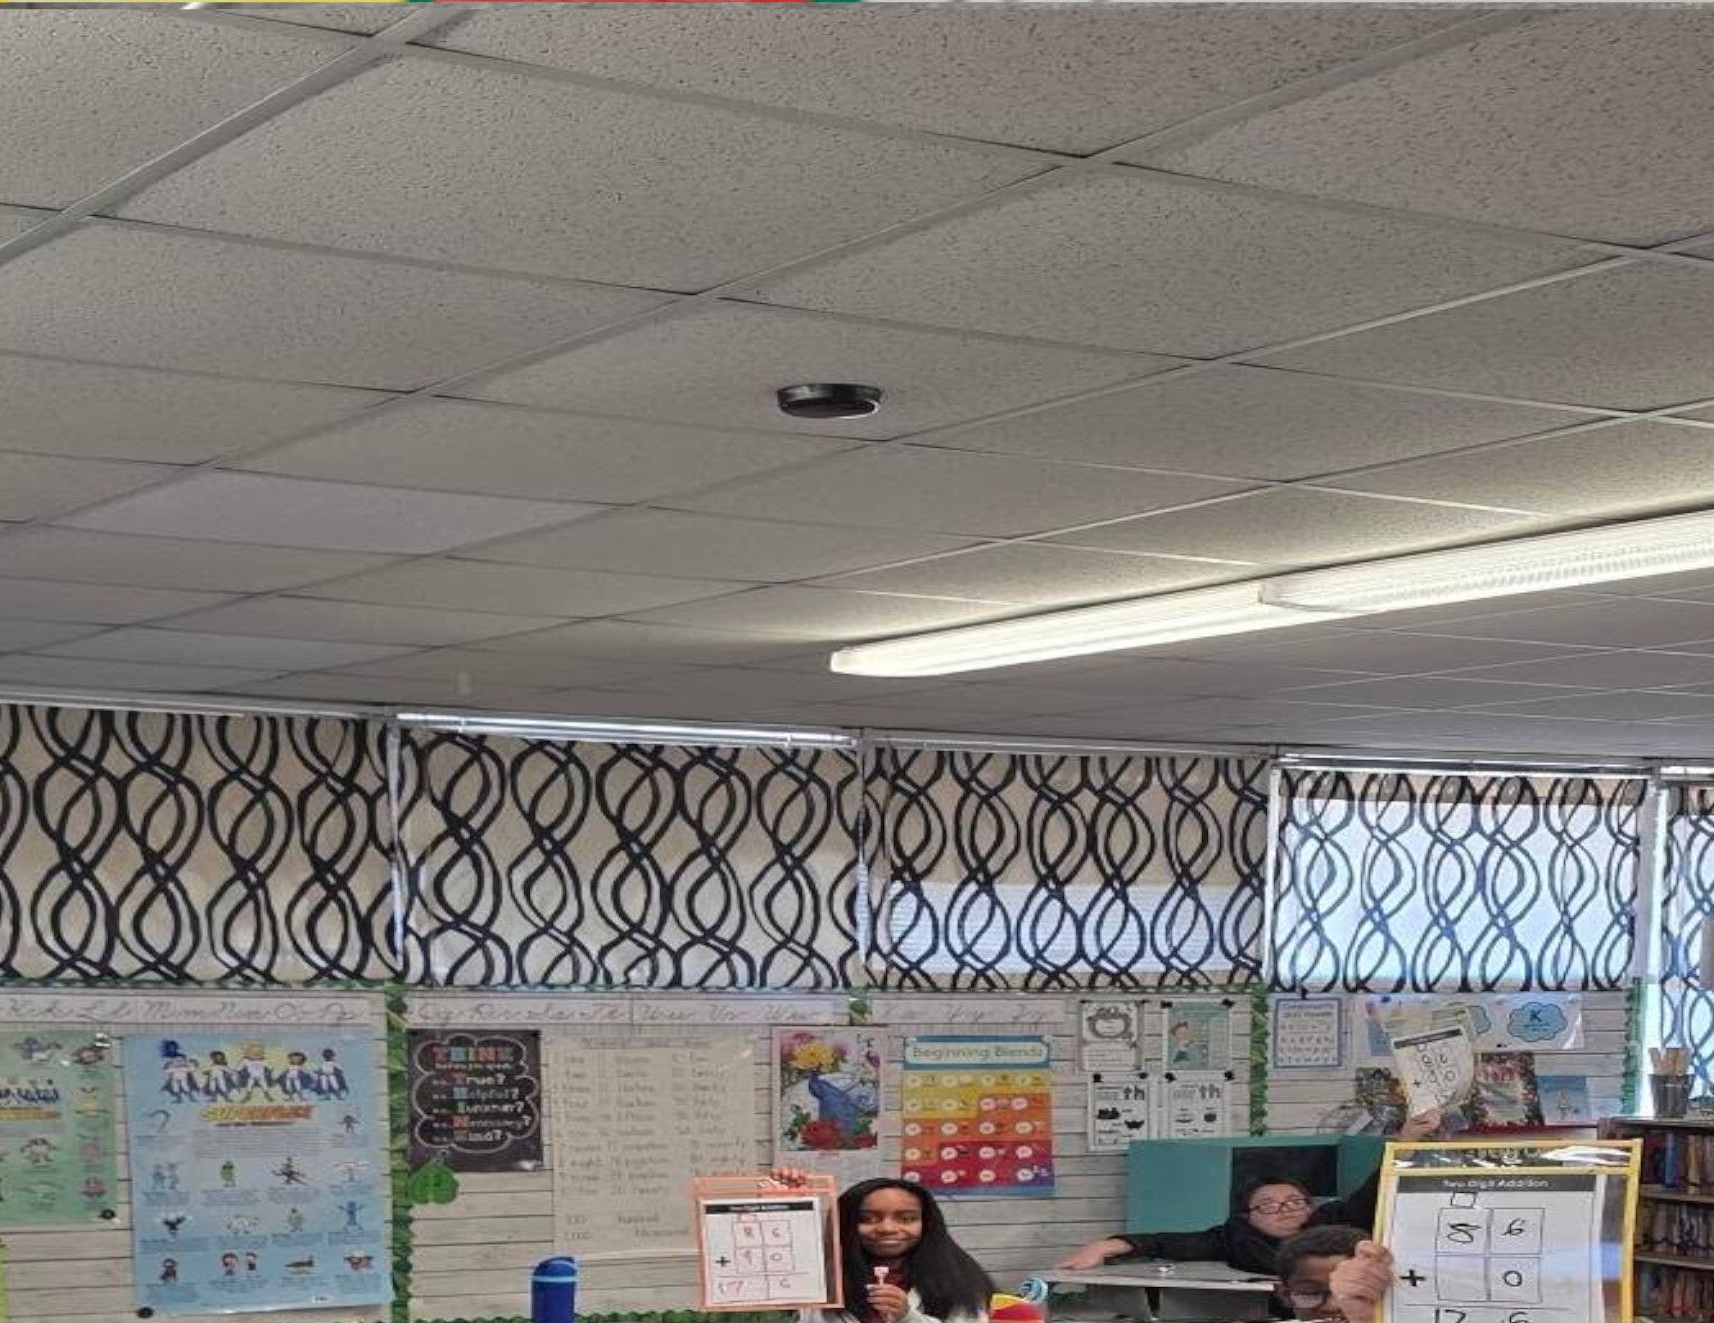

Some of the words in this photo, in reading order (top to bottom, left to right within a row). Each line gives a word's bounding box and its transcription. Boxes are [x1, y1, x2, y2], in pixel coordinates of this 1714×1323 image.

[432, 1046, 512, 1062] THINK
[1123, 1084, 1145, 1101] th
[1199, 1083, 1221, 1100] th
[1498, 1179, 1549, 1187] Addition
[1447, 1223, 1482, 1244] 8
[1502, 1218, 1526, 1236] 6
[1502, 1270, 1523, 1287] 0
